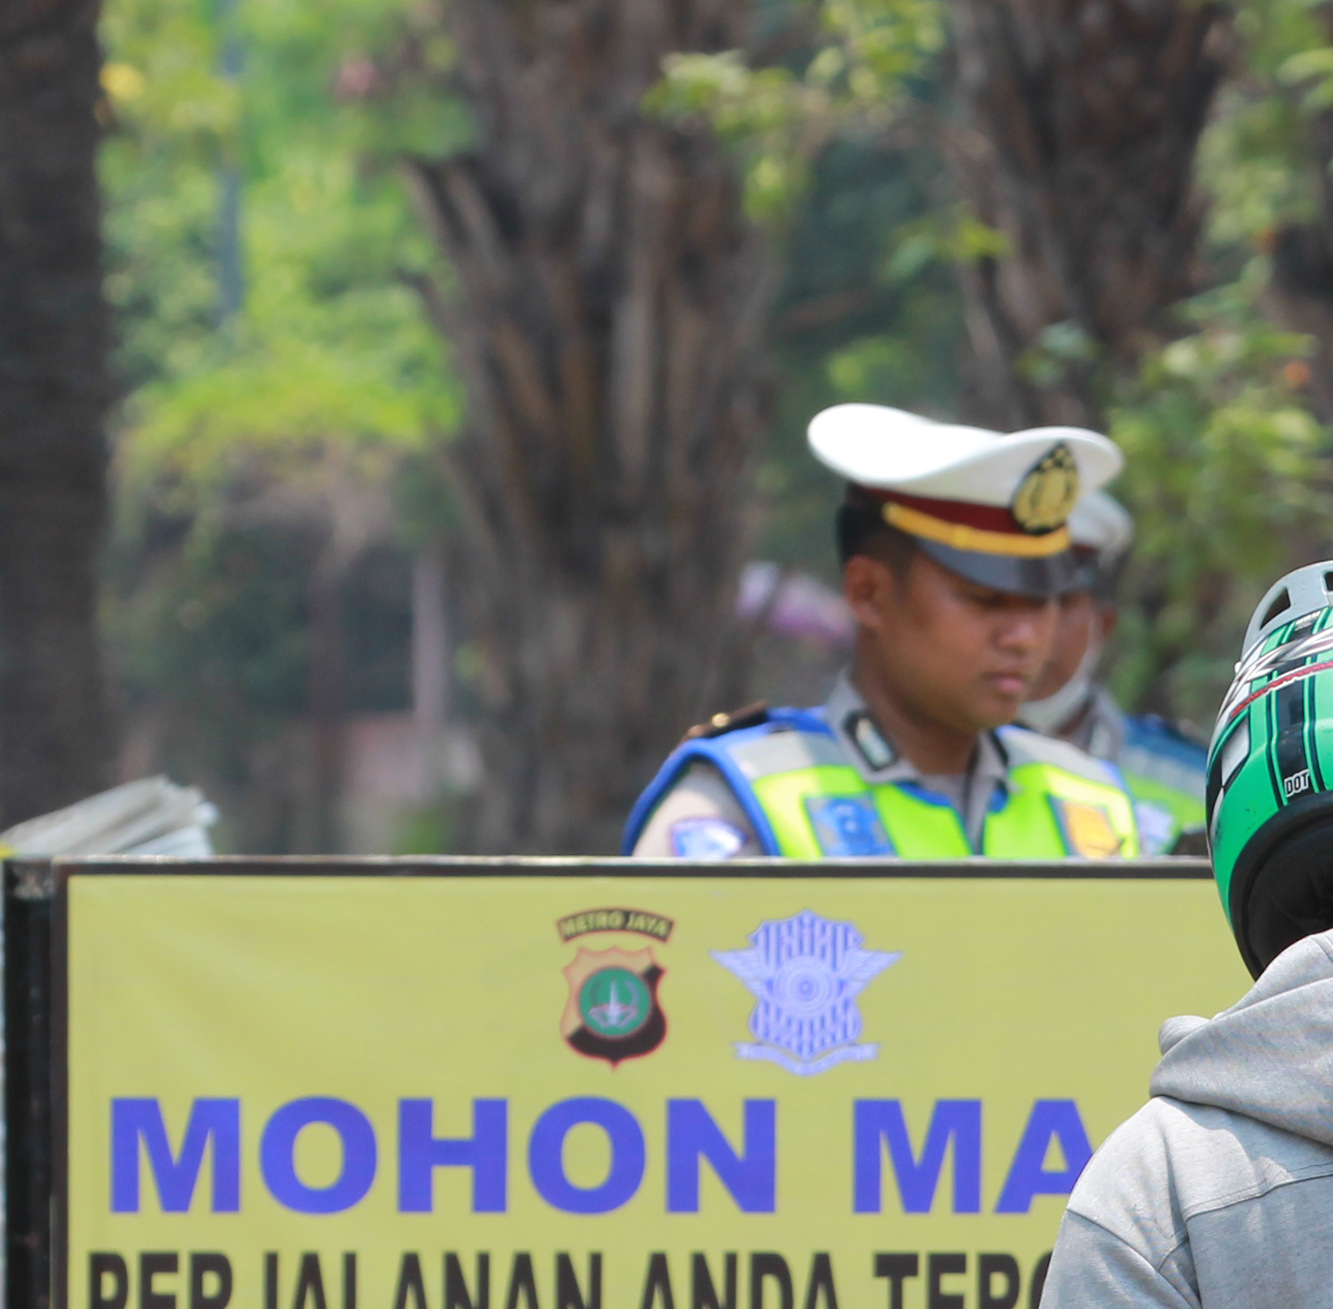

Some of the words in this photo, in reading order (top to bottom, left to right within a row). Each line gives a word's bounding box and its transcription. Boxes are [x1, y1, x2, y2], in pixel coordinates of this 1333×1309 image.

[1284, 769, 1310, 797] DOT
[110, 1096, 777, 1215] MOHON
[852, 1098, 1095, 1214] MA
